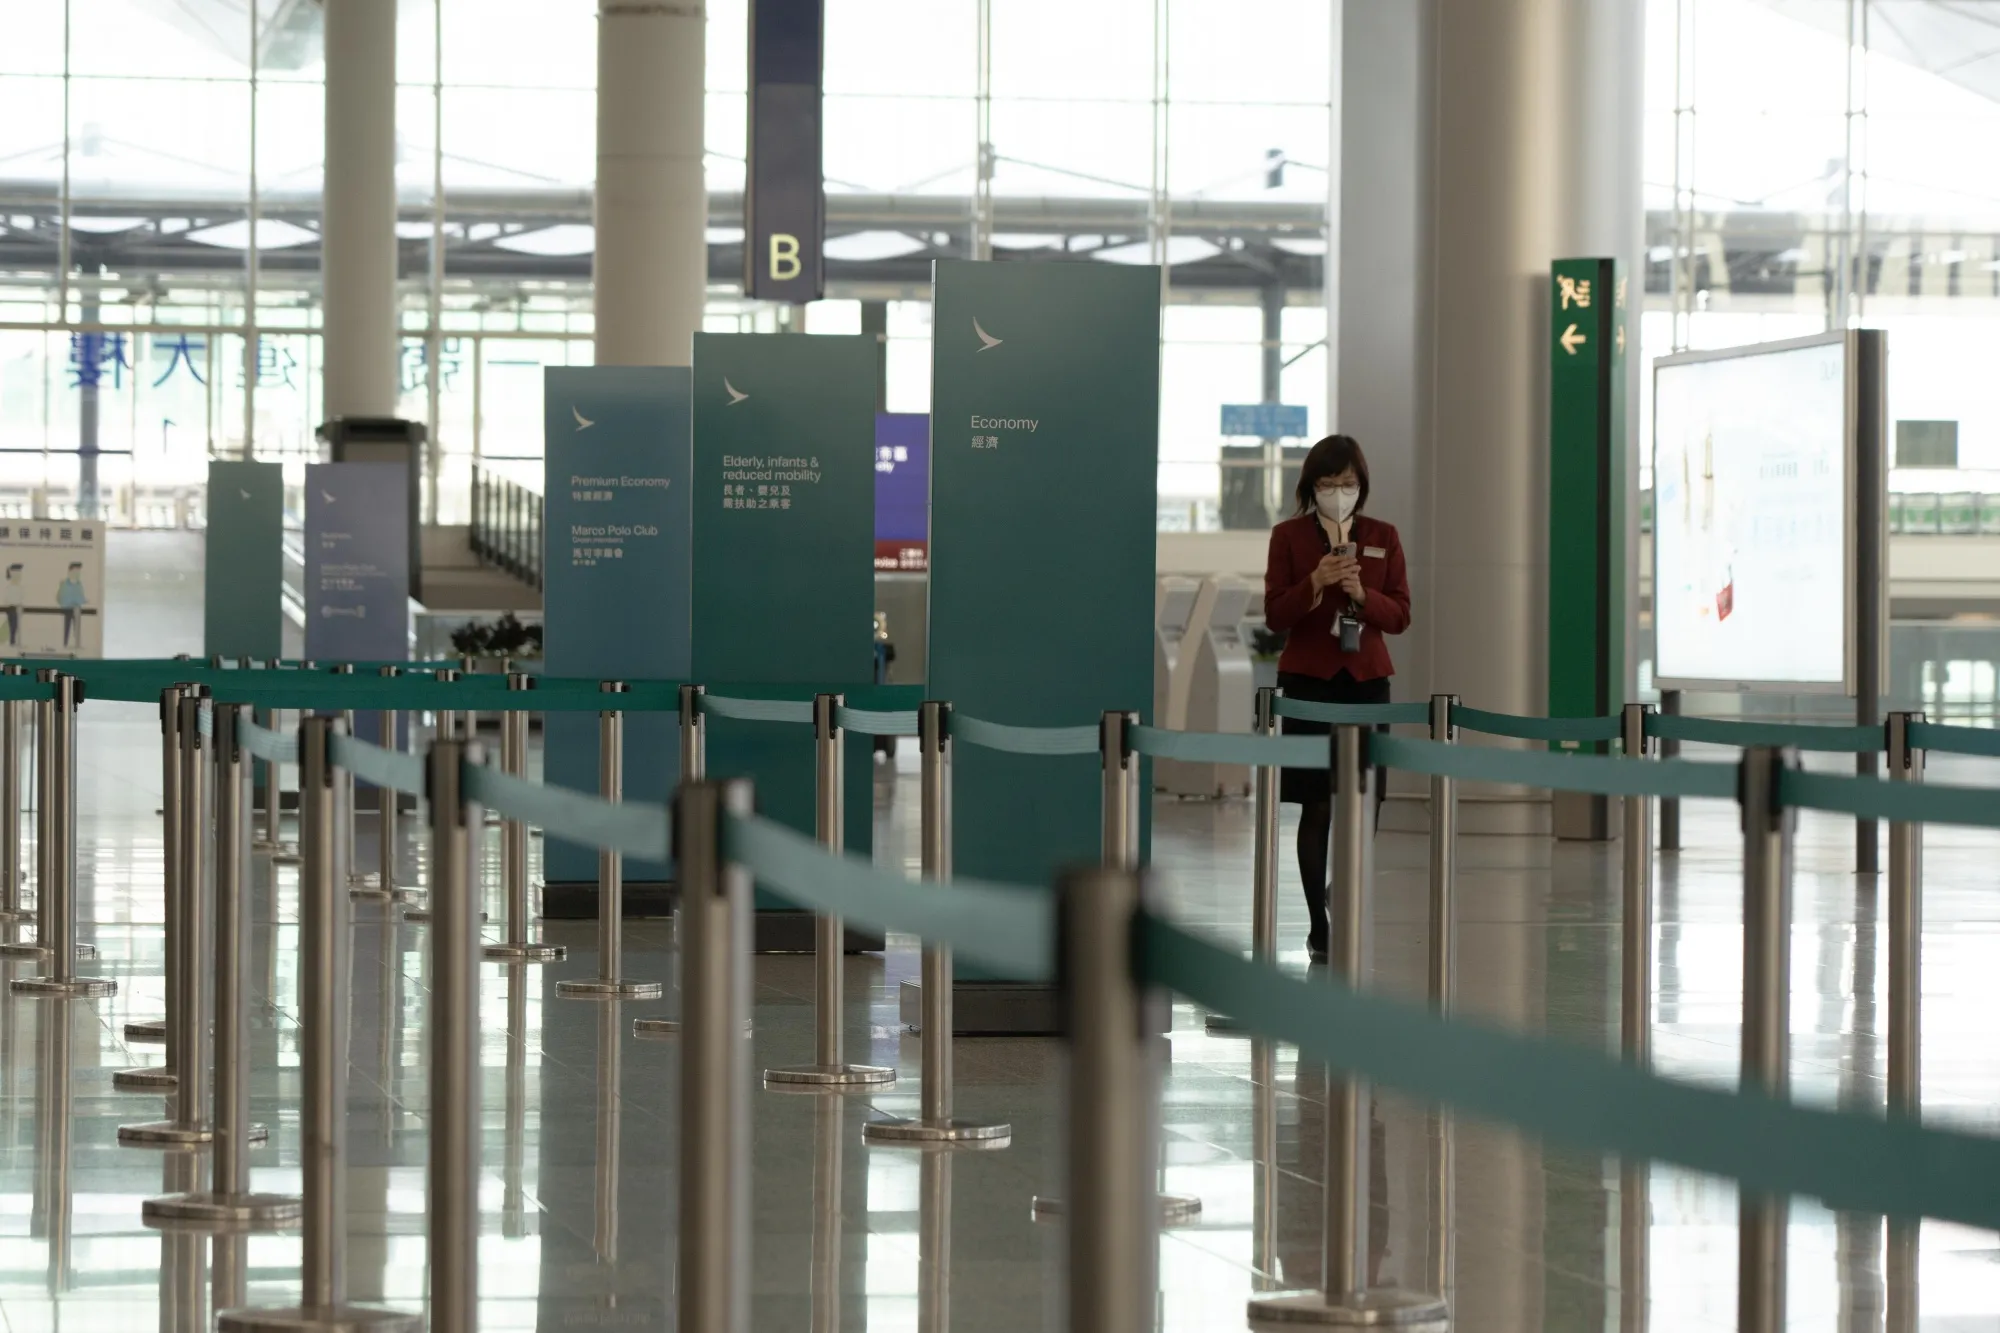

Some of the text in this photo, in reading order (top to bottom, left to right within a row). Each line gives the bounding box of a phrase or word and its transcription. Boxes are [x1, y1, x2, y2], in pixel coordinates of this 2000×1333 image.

[769, 233, 801, 281] B
[971, 415, 1039, 433] Economy
[971, 435, 999, 449] 經濟
[723, 455, 819, 469] Elderly, infants &
[571, 475, 671, 490] Premium Economy
[723, 469, 822, 483] reduced mobility
[571, 525, 659, 536] Marco Polo Club
